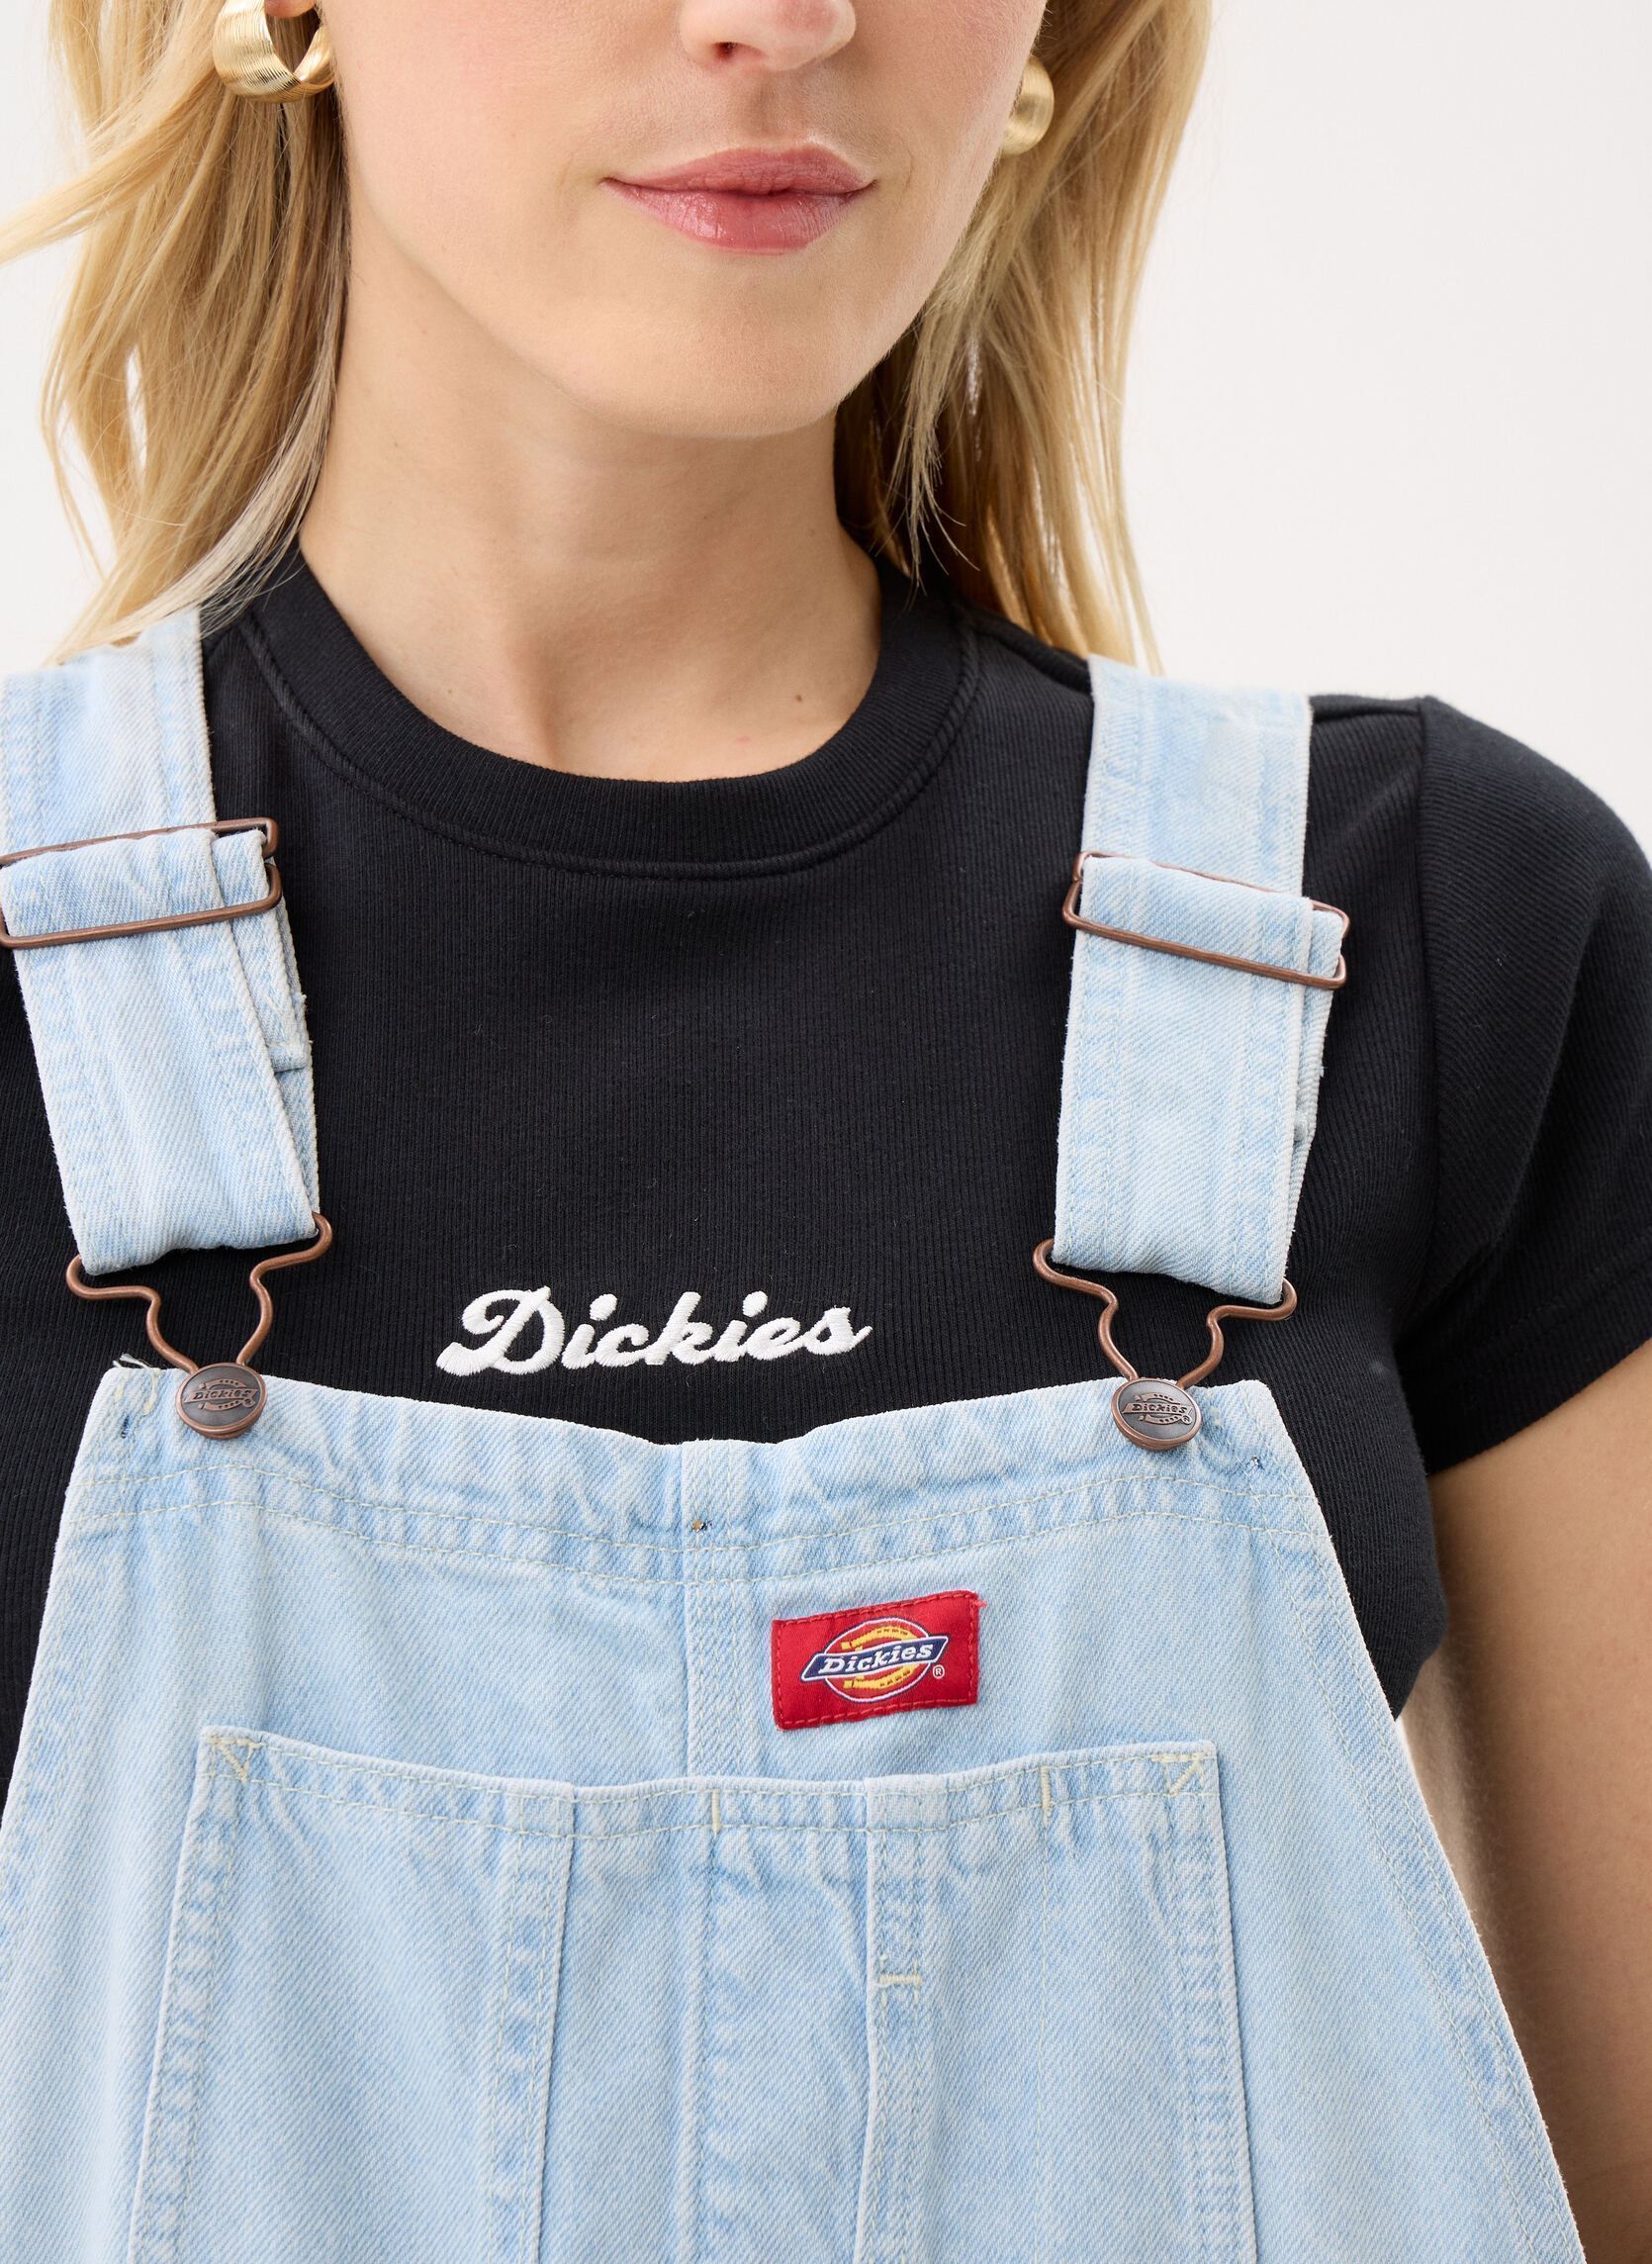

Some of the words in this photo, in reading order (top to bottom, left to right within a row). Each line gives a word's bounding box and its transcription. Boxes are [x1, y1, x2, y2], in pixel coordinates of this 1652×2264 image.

[436, 1285, 872, 1376] Dickies
[1132, 1403, 1187, 1415] Dickies
[817, 1643, 935, 1674] Dickies
